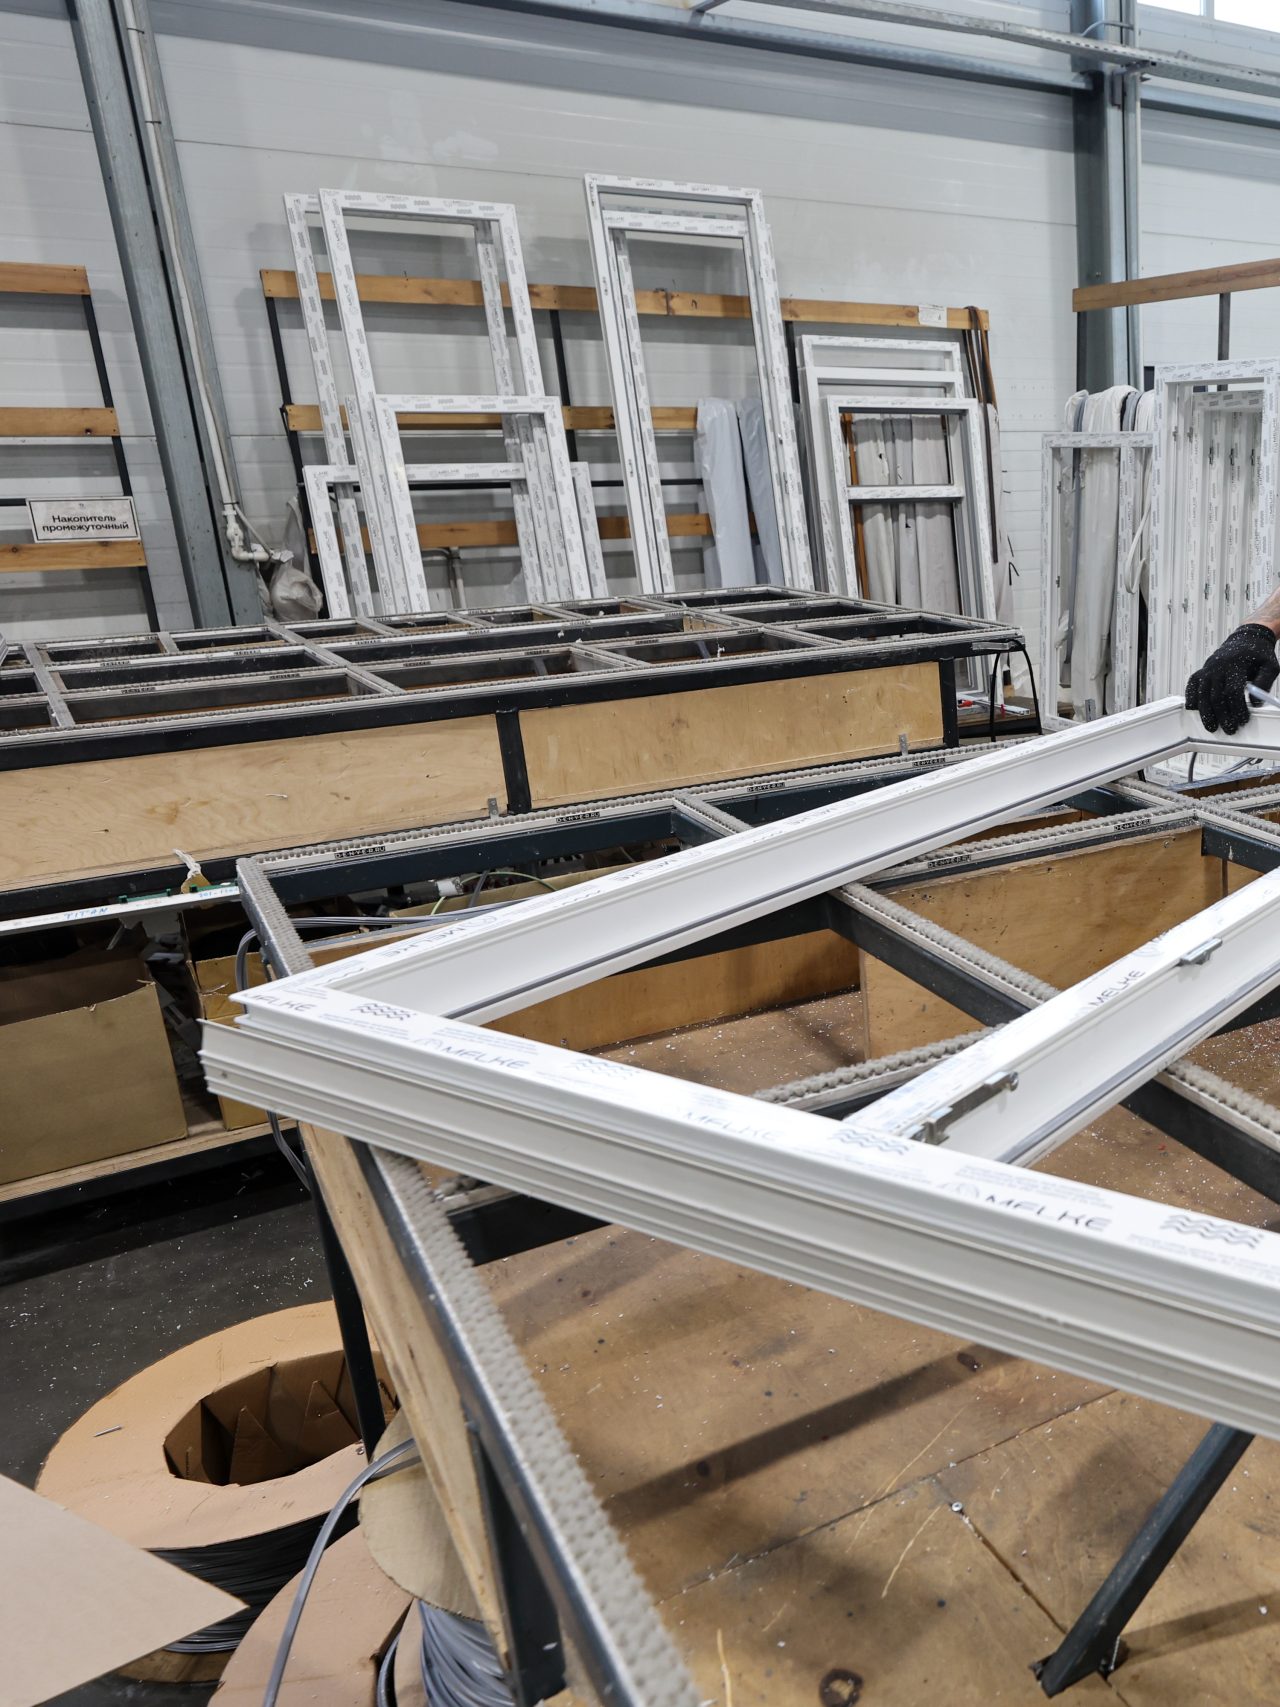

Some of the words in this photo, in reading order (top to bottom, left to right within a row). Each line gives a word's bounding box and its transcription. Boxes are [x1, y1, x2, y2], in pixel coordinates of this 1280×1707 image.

[42, 521, 129, 533] промежуточный
[52, 515, 116, 523] Накопитель
[1087, 969, 1146, 1008] MELKE
[441, 1046, 530, 1070] MELKE
[985, 1194, 1113, 1232] MELKE
